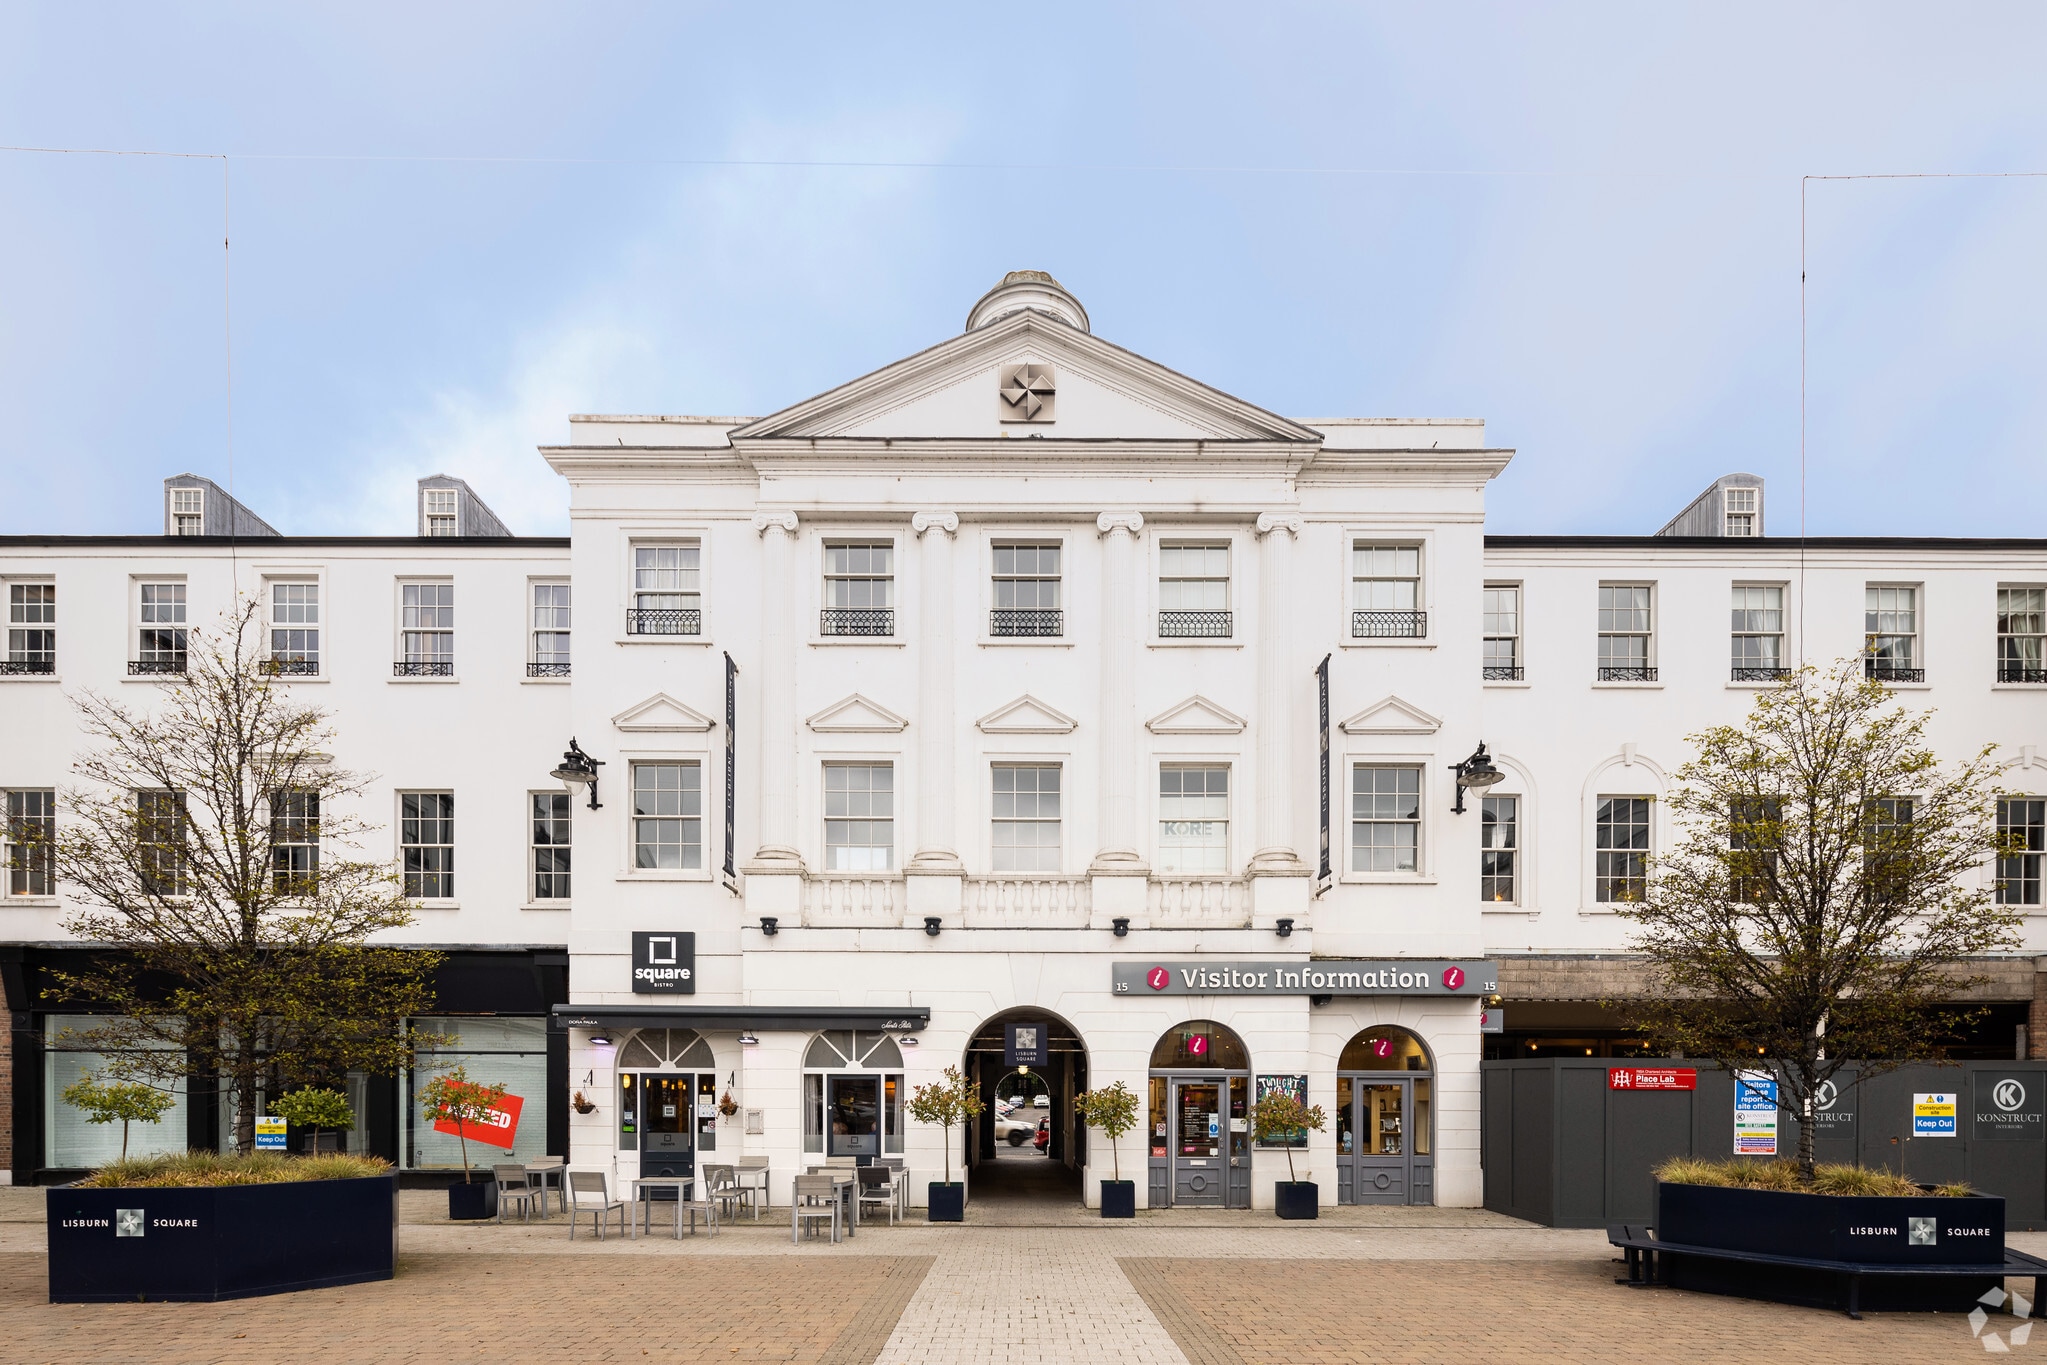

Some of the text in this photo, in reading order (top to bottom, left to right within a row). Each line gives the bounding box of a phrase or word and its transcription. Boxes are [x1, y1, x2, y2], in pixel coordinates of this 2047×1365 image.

[1164, 822, 1212, 836] KORE
[635, 968, 691, 983] square
[1180, 967, 1269, 989] Visitor
[1275, 967, 1430, 989] Information
[1116, 982, 1129, 992] 15
[1483, 982, 1496, 991] 15
[1636, 1075, 1675, 1083] Place Lab
[1741, 1096, 1763, 1104] report
[1789, 1113, 1854, 1122] KSTRUCT
[1976, 1113, 2042, 1122] KONSTRUCT
[1917, 1119, 1953, 1129] Keep Out
[62, 1219, 198, 1228] LISBURN SQUARE
[1850, 1226, 1991, 1236] LISBURN SQUARE
